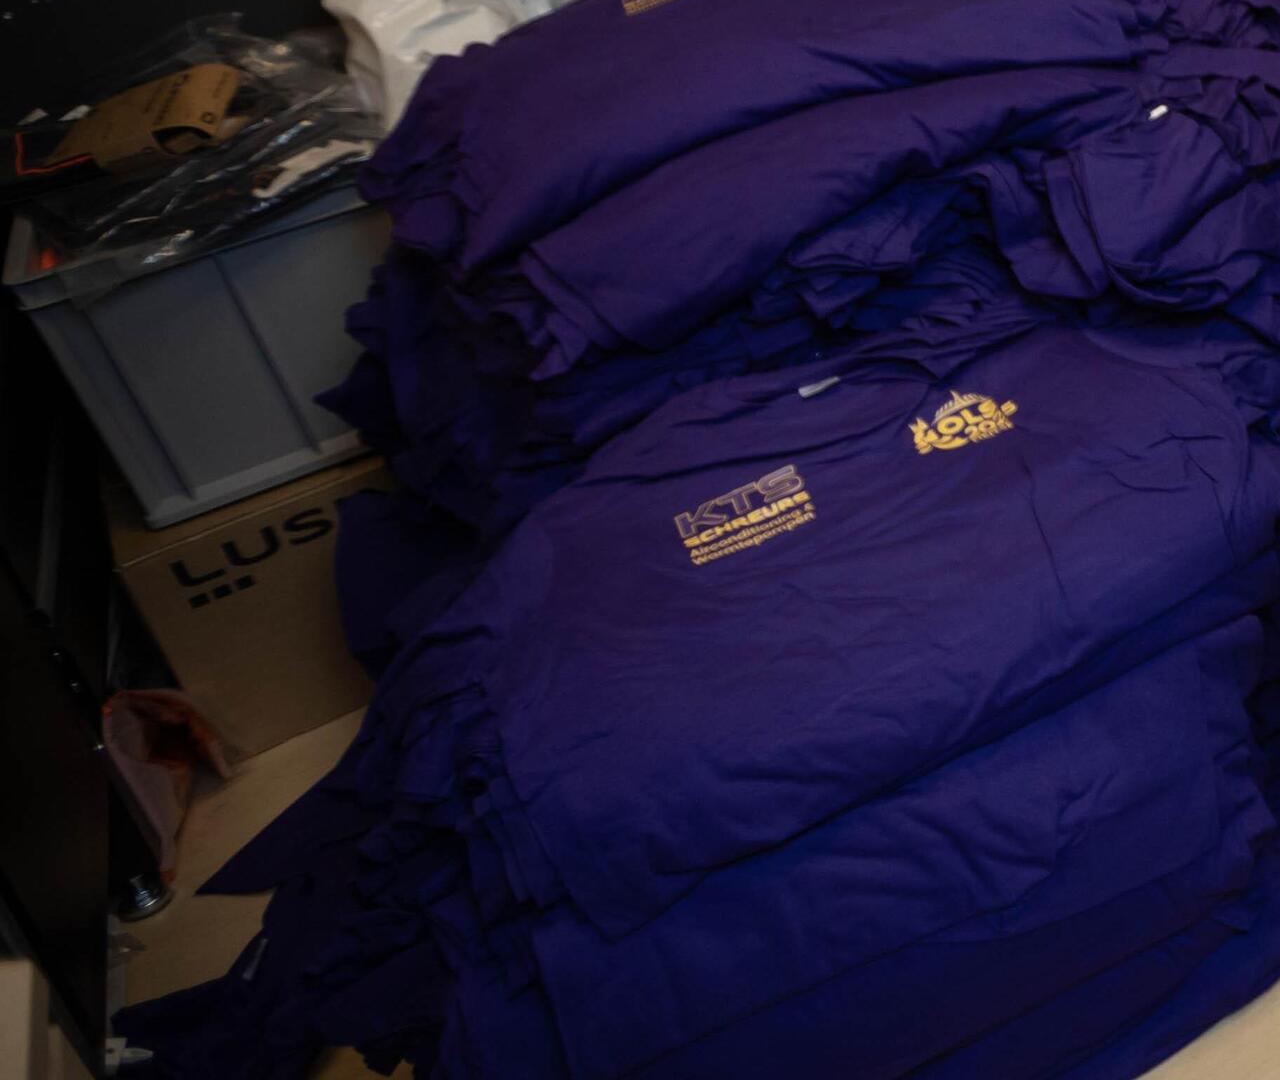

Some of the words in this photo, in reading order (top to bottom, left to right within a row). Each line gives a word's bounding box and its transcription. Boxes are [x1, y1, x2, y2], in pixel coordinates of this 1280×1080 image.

[937, 399, 997, 436] OLS
[674, 464, 804, 539] KTS
[683, 490, 811, 548] SCHREURS
